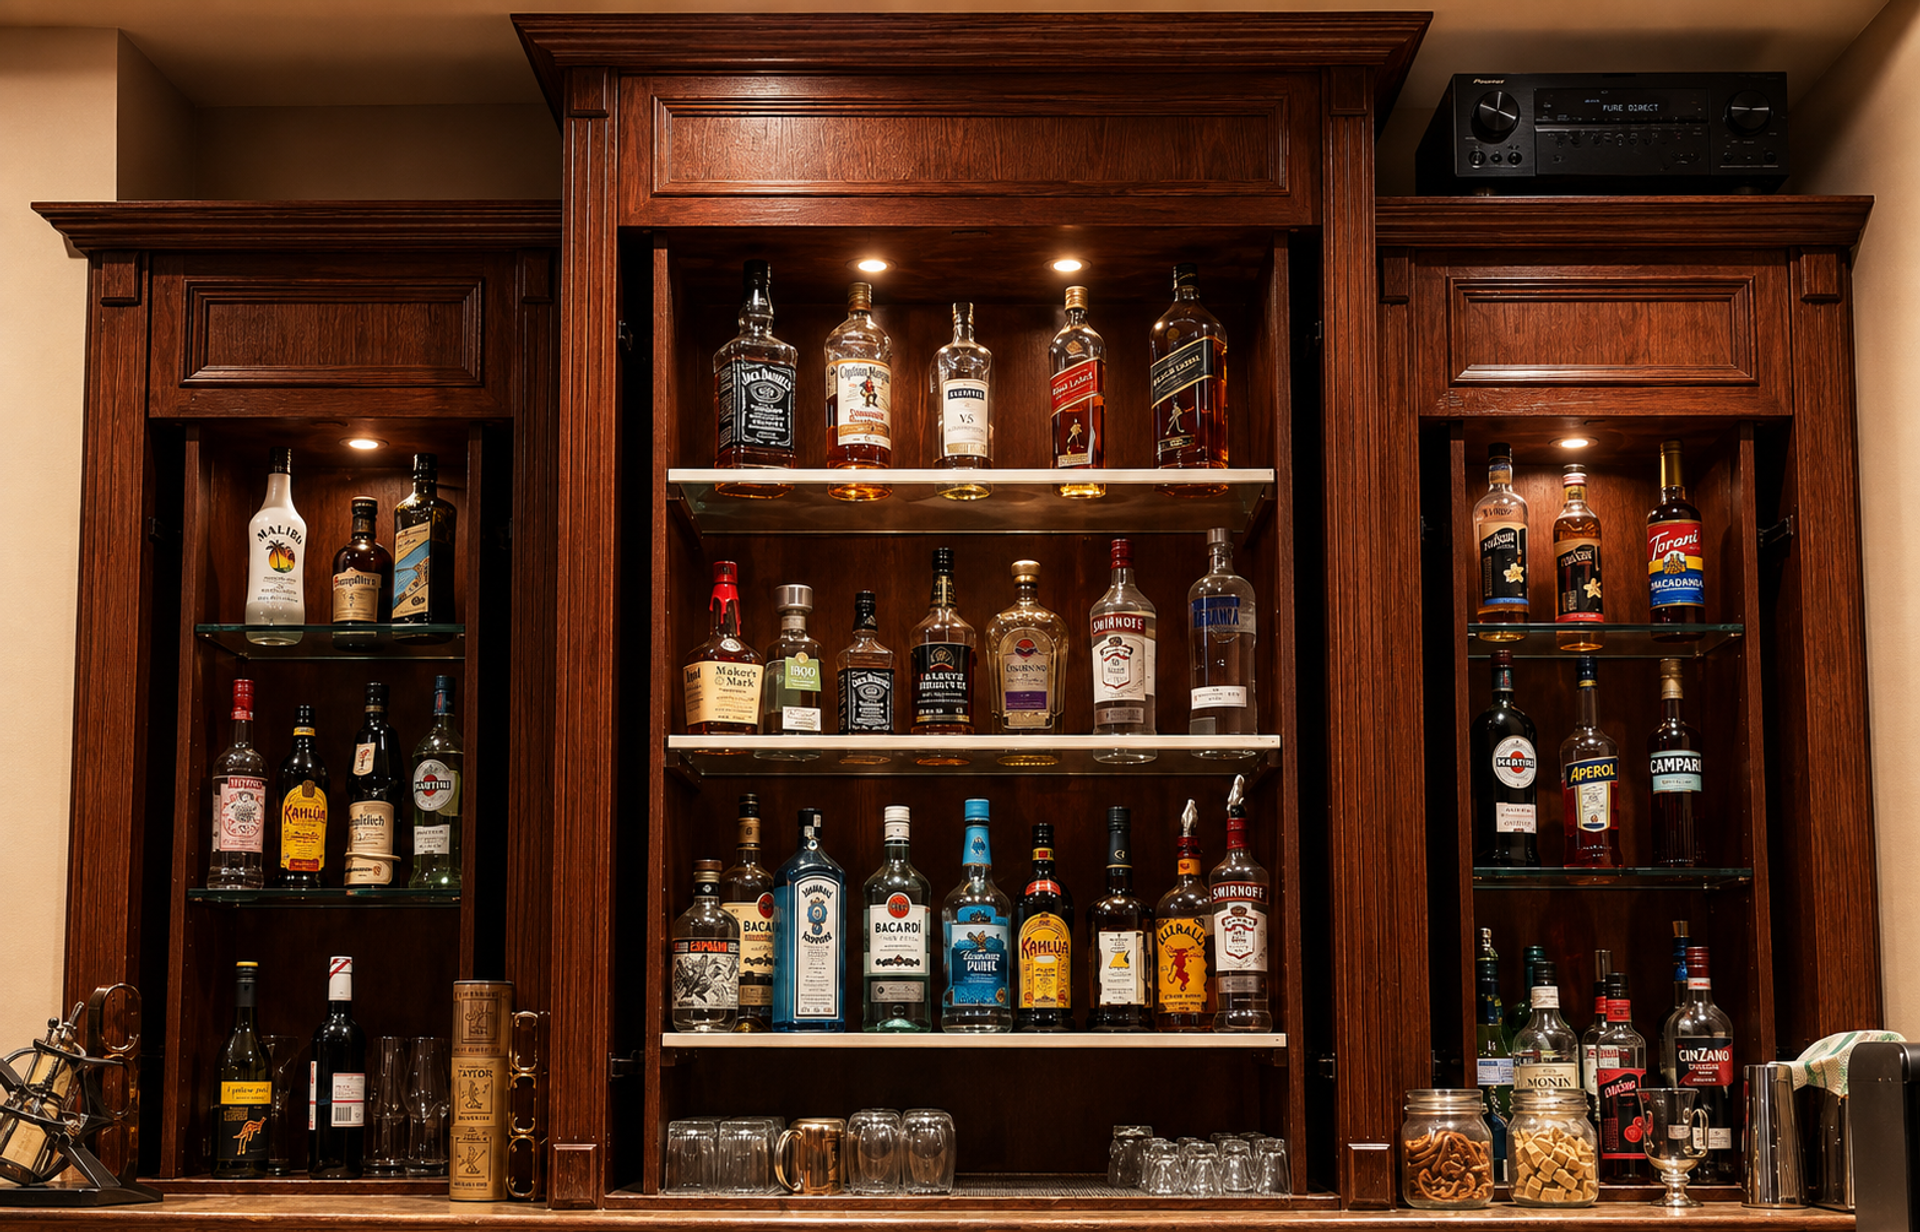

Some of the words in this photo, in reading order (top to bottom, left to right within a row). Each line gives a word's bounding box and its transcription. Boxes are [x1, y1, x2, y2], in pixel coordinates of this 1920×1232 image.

[1650, 529, 1698, 561] Torani
[726, 675, 755, 688] Mark
[1570, 762, 1616, 783] APEROL
[1650, 757, 1702, 774] CAMPARI
[1678, 1046, 1730, 1063] CINZANO
[1527, 1077, 1571, 1088] MONIN
